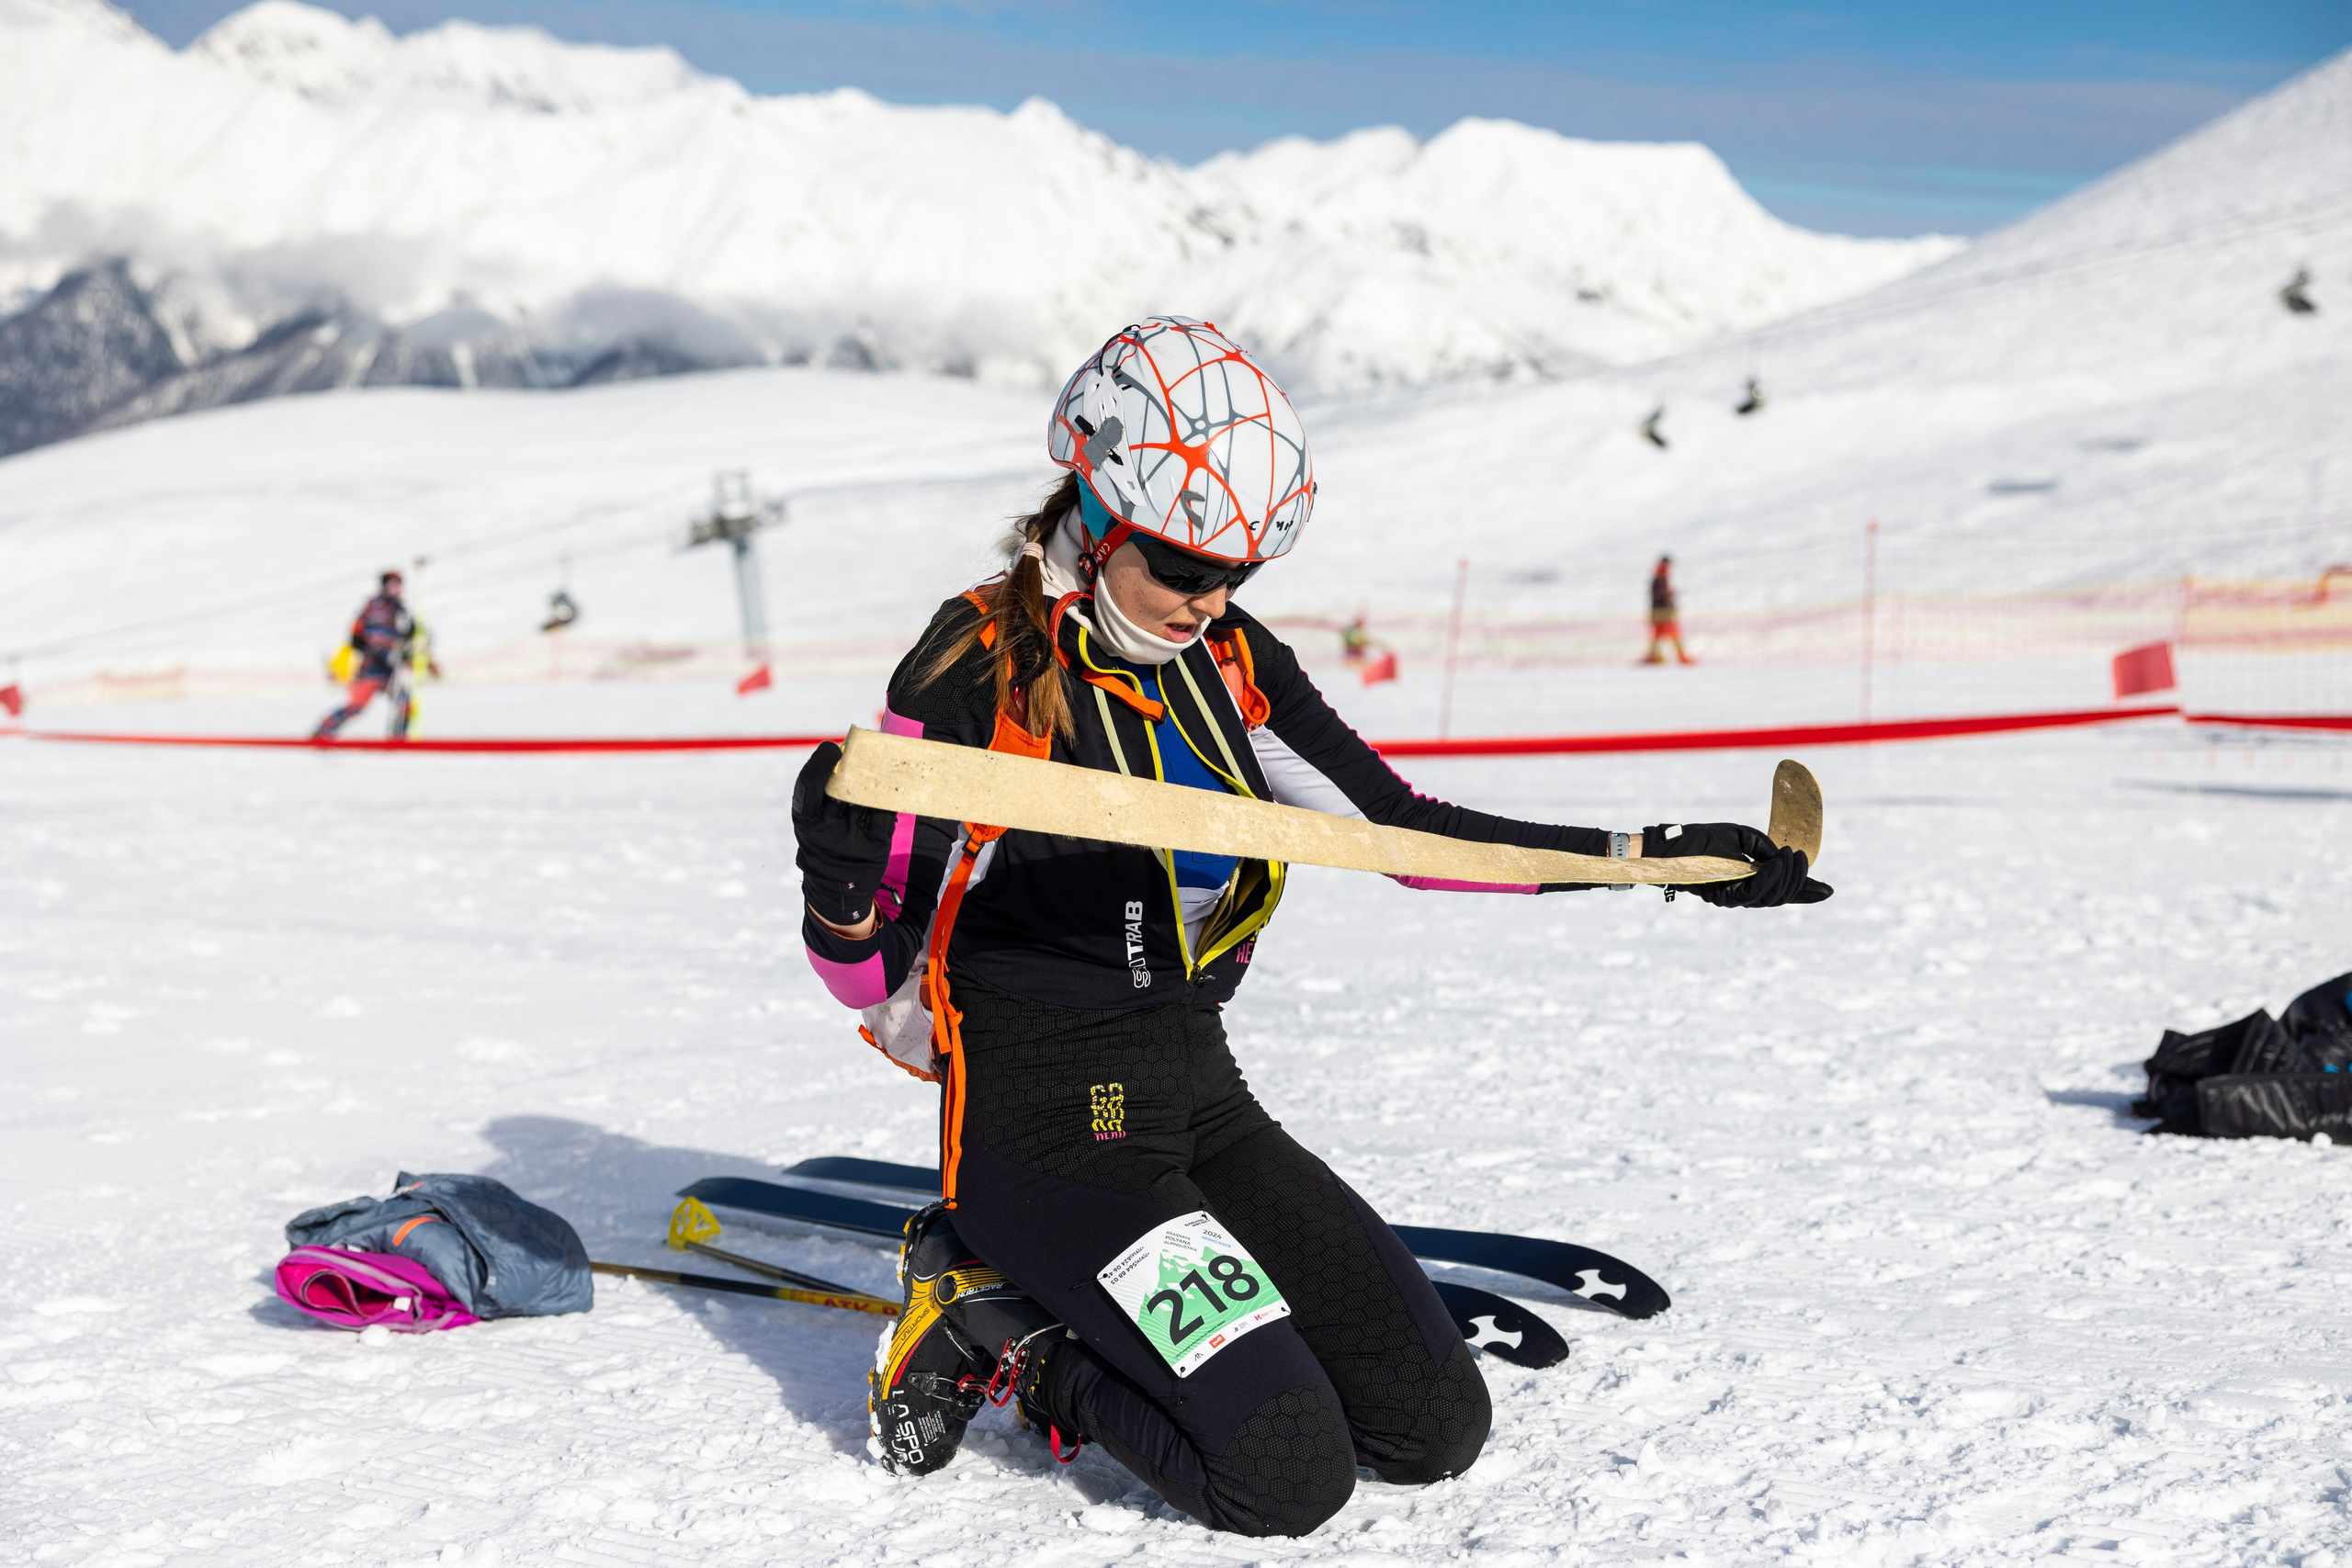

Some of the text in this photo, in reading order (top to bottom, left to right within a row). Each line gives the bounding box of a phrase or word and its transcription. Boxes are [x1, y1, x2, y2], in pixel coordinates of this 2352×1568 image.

[1249, 521, 1294, 531] CMP
[1203, 1229, 1222, 1239] 2024
[1165, 1235, 1191, 1246] POLYANA
[1110, 1277, 1119, 1285] 03
[956, 1282, 1003, 1299] RACETRON
[1147, 1255, 1260, 1346] 218
